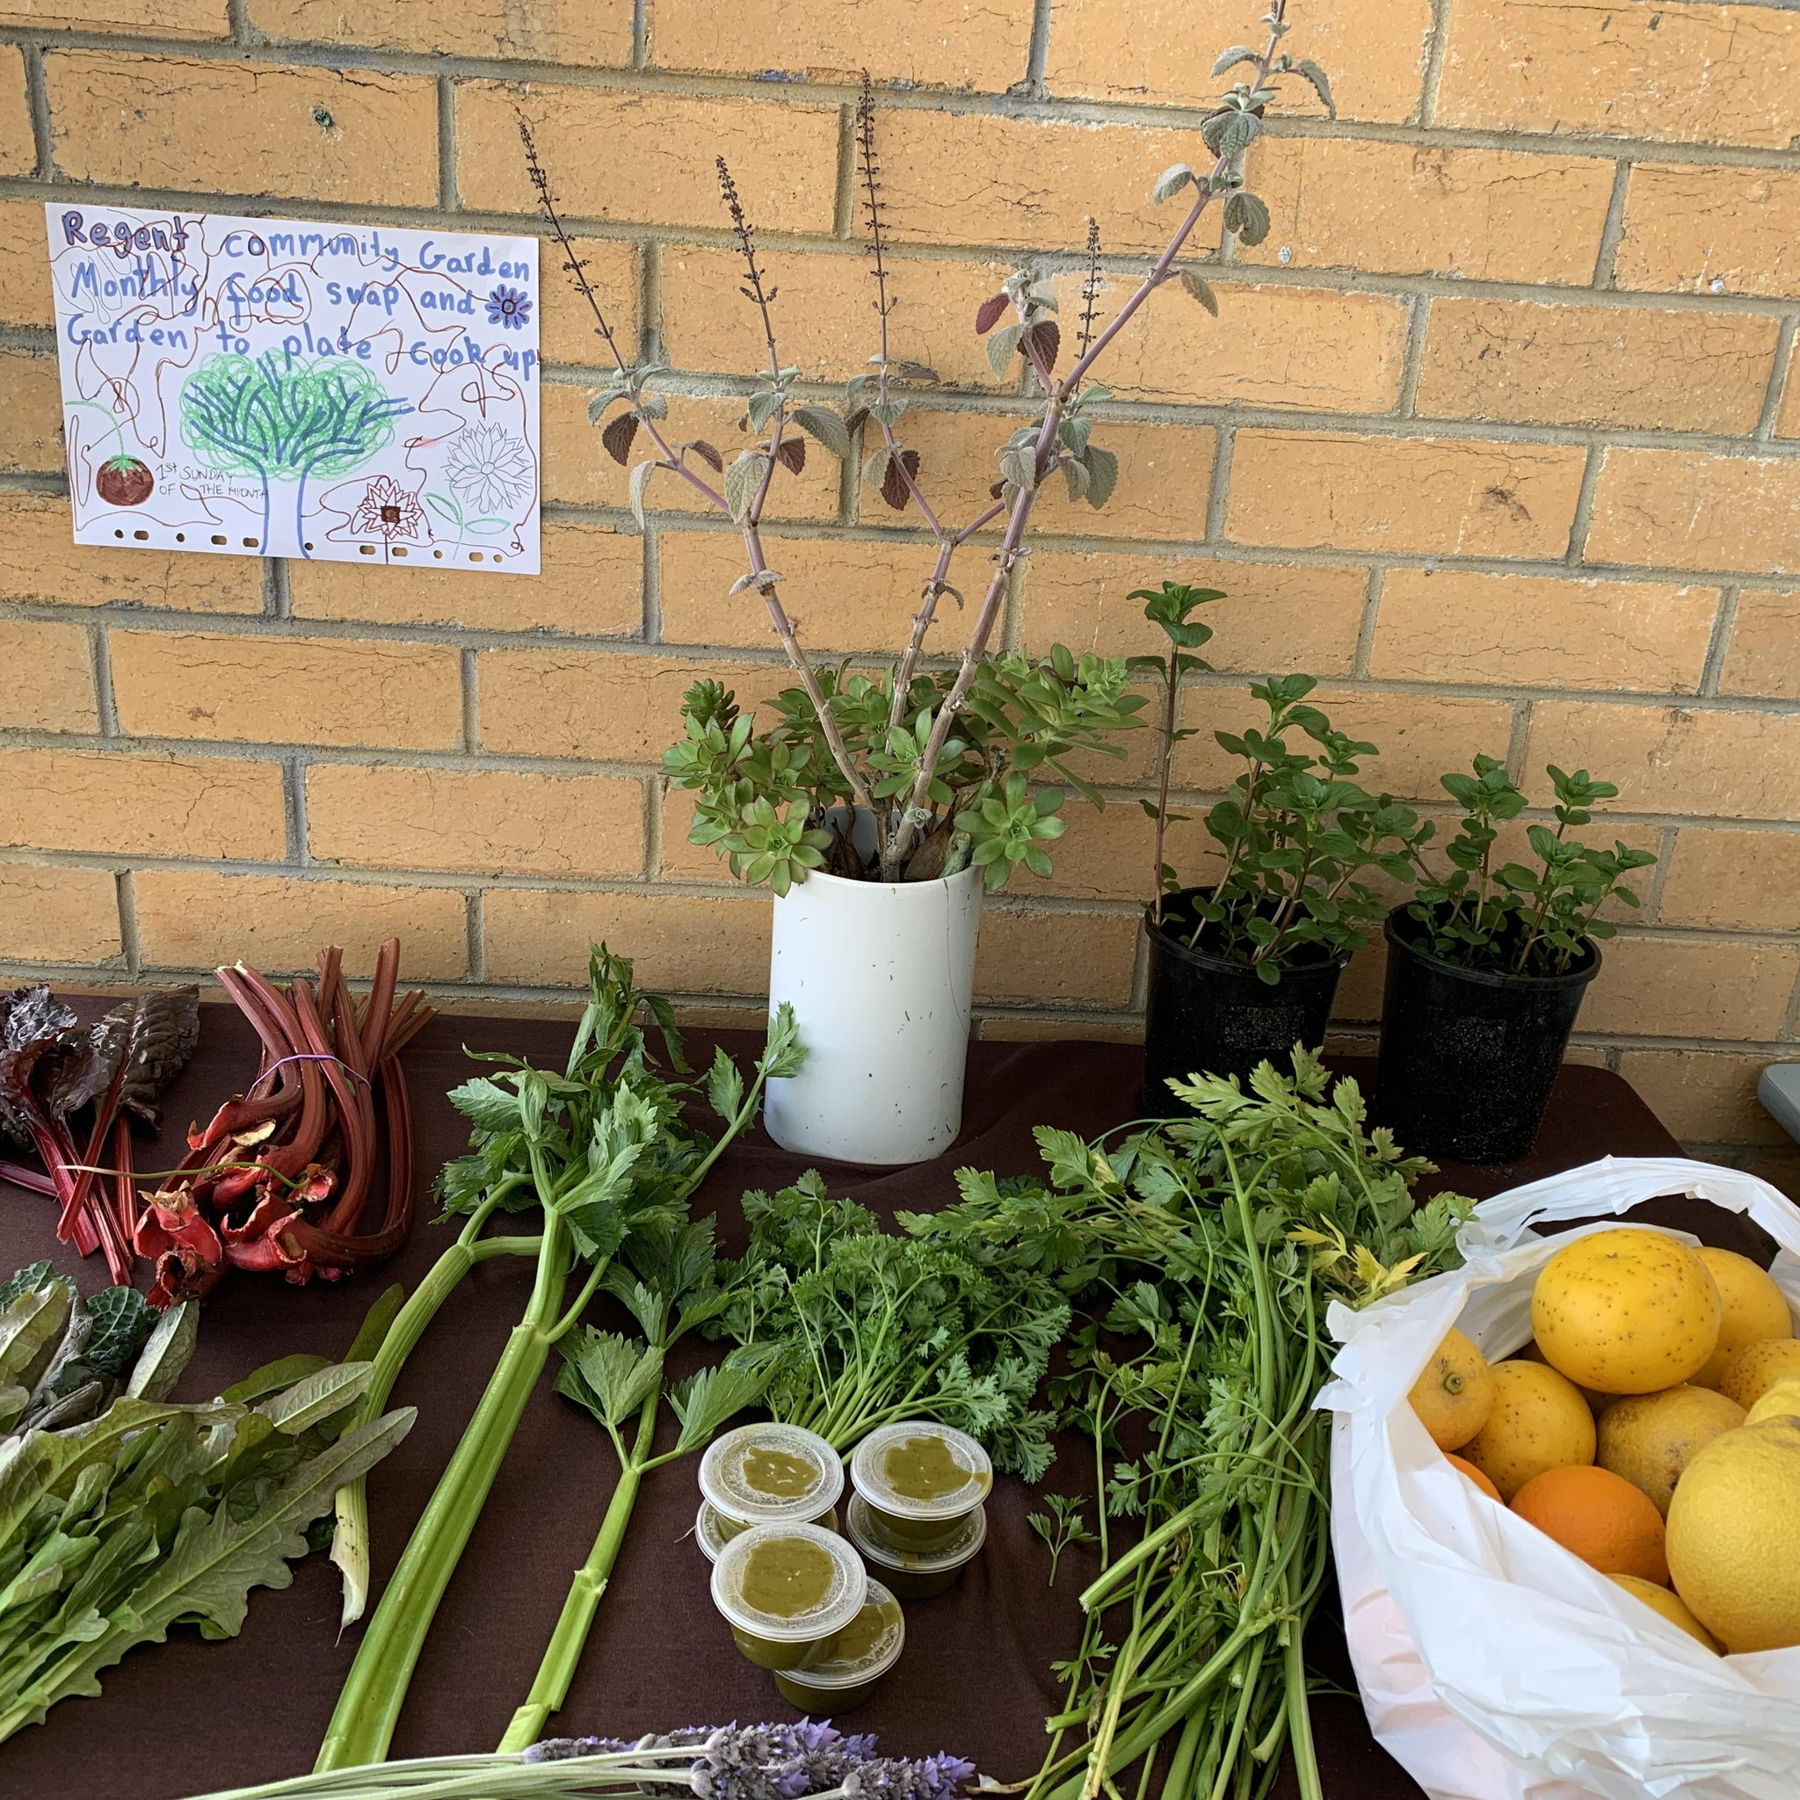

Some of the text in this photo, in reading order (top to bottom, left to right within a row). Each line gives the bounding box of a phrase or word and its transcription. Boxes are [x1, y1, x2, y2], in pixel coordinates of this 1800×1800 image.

[61, 210, 189, 259] Regent
[419, 241, 529, 282] Garden
[71, 255, 476, 326] Monthly food swap and
[67, 313, 188, 350] Garden
[216, 320, 250, 355] to
[283, 322, 372, 371] plate
[159, 483, 175, 496] OF
[199, 484, 224, 496] THE
[180, 466, 233, 485] SUNDAY
